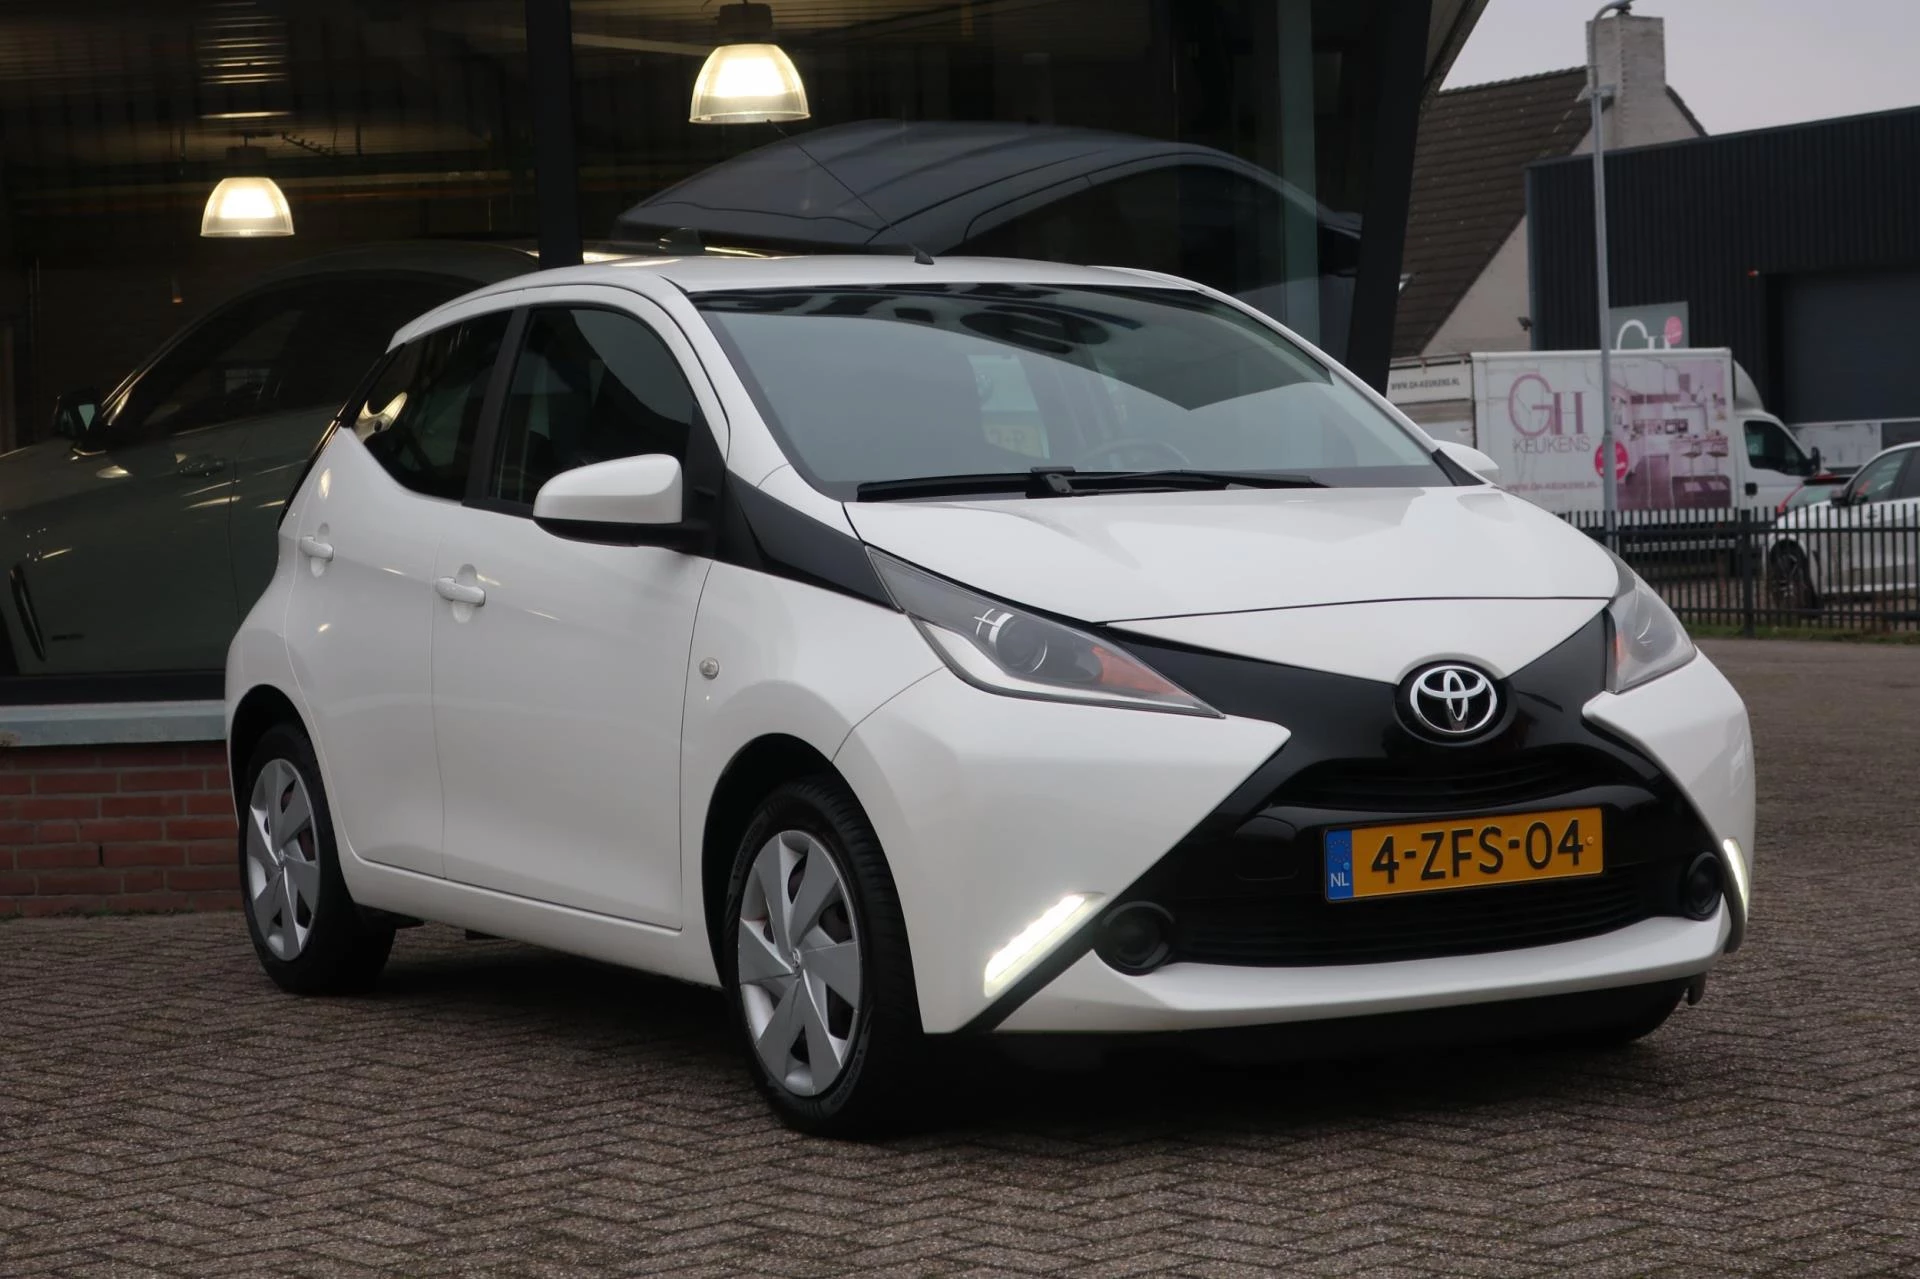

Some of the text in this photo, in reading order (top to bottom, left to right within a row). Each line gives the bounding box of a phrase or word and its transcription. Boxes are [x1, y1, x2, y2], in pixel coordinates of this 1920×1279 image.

[1512, 435, 1592, 454] KEUKENS
[1371, 817, 1584, 884] 4-ZFS-04
[1330, 871, 1350, 888] NL
